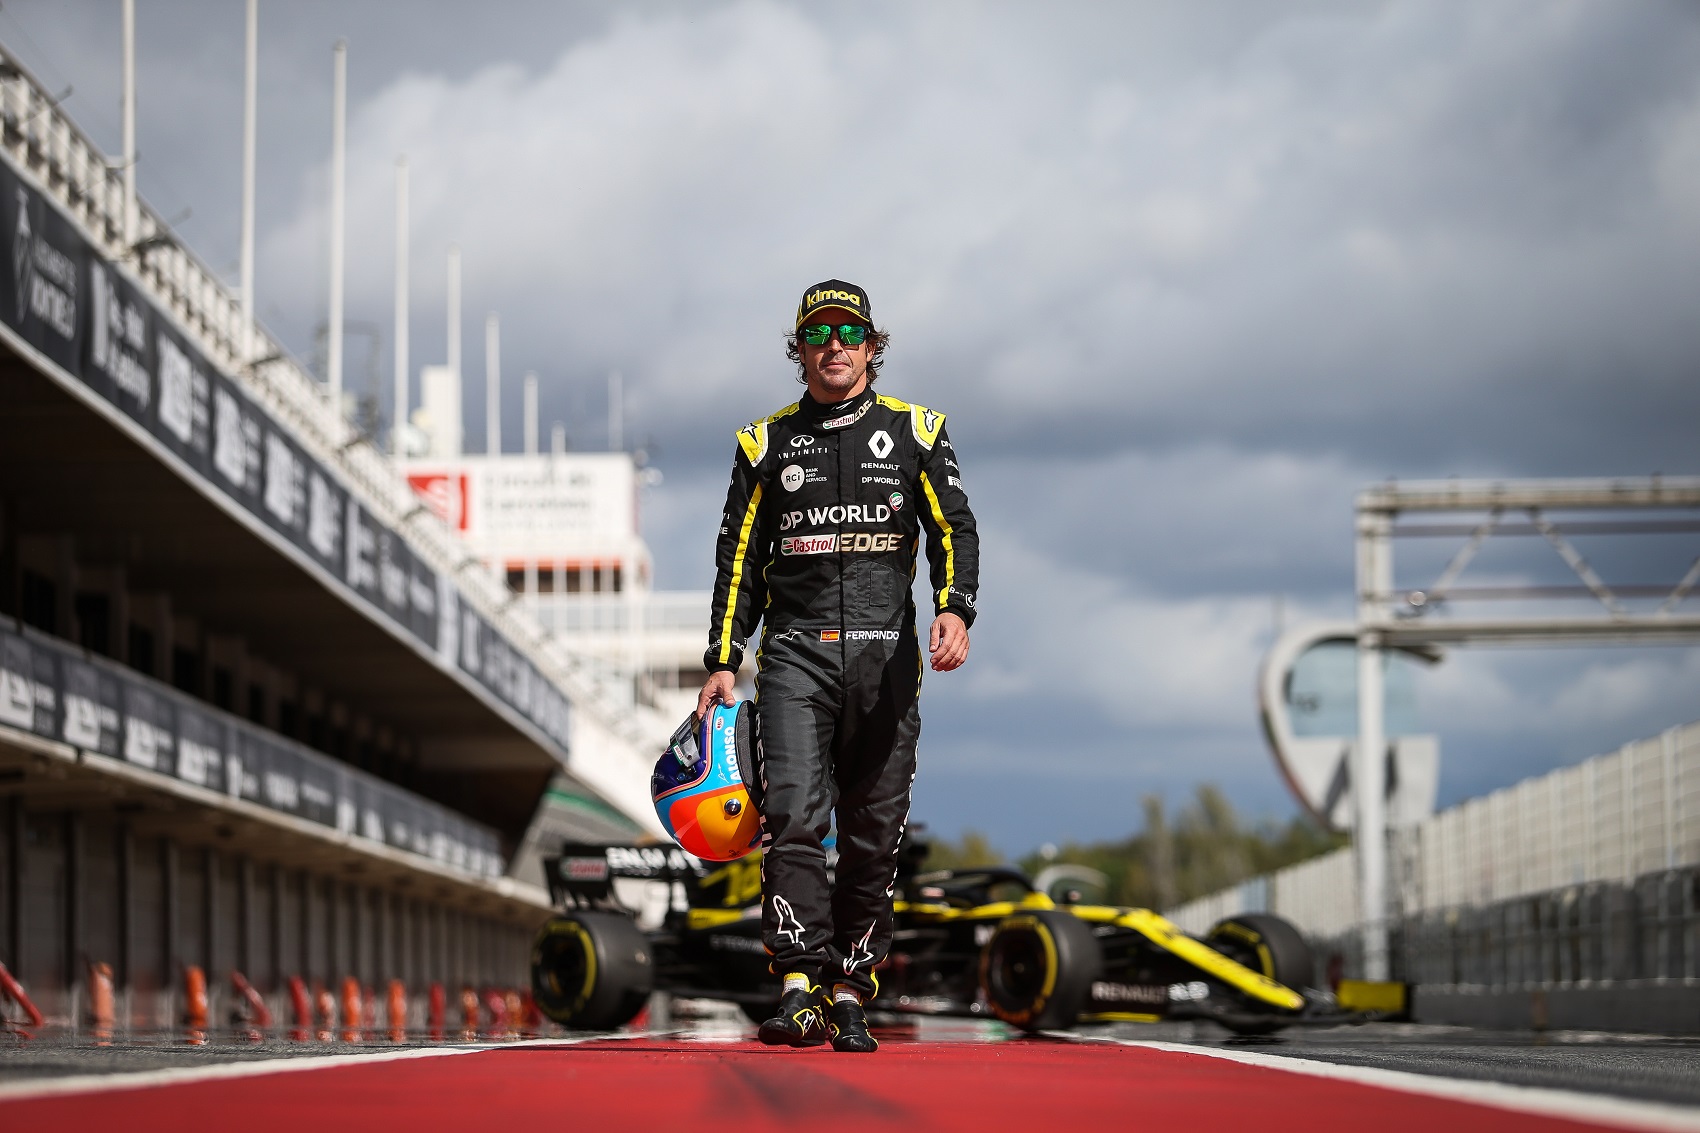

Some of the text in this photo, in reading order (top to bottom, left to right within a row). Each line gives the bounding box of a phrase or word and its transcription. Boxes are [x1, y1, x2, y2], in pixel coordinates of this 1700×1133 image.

[806, 289, 861, 309] kimoa
[831, 415, 854, 427] Castrol
[778, 447, 828, 459] INFINITI
[861, 462, 900, 471] RENAULT
[785, 472, 801, 483] RCi
[861, 476, 901, 486] DP WORLD
[779, 504, 891, 531] DP WORLD
[793, 532, 905, 553] Castrol EDGE
[845, 630, 900, 641] FERNANDO
[724, 726, 742, 781] ALONSO
